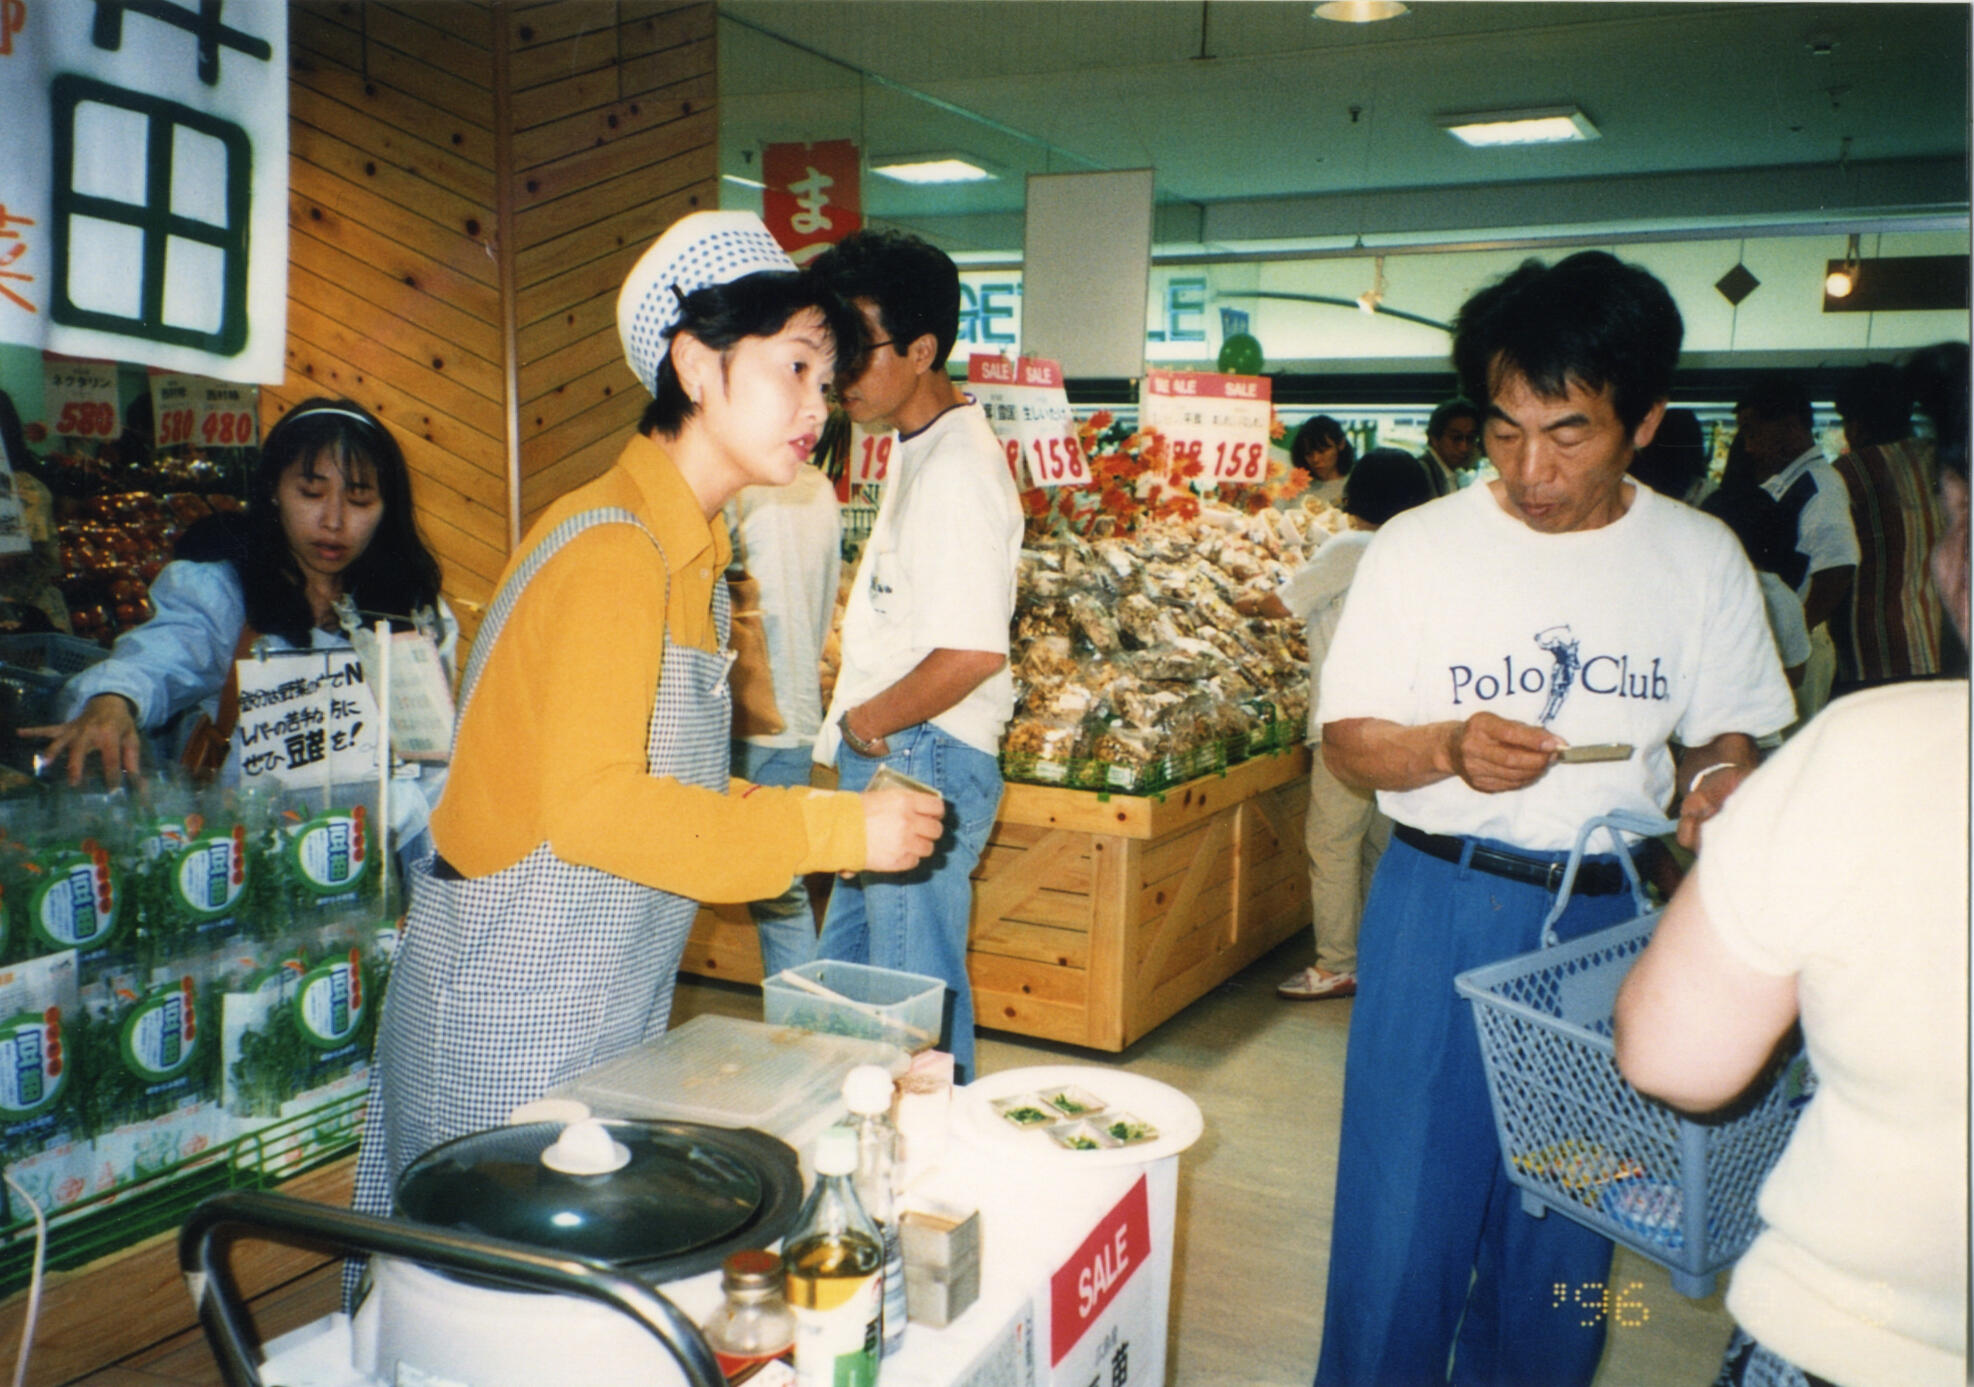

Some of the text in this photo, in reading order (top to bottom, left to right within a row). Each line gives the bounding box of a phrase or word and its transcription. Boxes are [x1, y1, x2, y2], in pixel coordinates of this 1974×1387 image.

[981, 361, 1010, 380] SALE
[1024, 365, 1053, 385] SALE
[1224, 381, 1258, 399] SALE
[201, 411, 253, 445] 480
[1032, 436, 1084, 480] 158
[1213, 440, 1264, 479] 158
[1449, 654, 1669, 704] Polo Club
[1078, 1222, 1130, 1319] SALE
